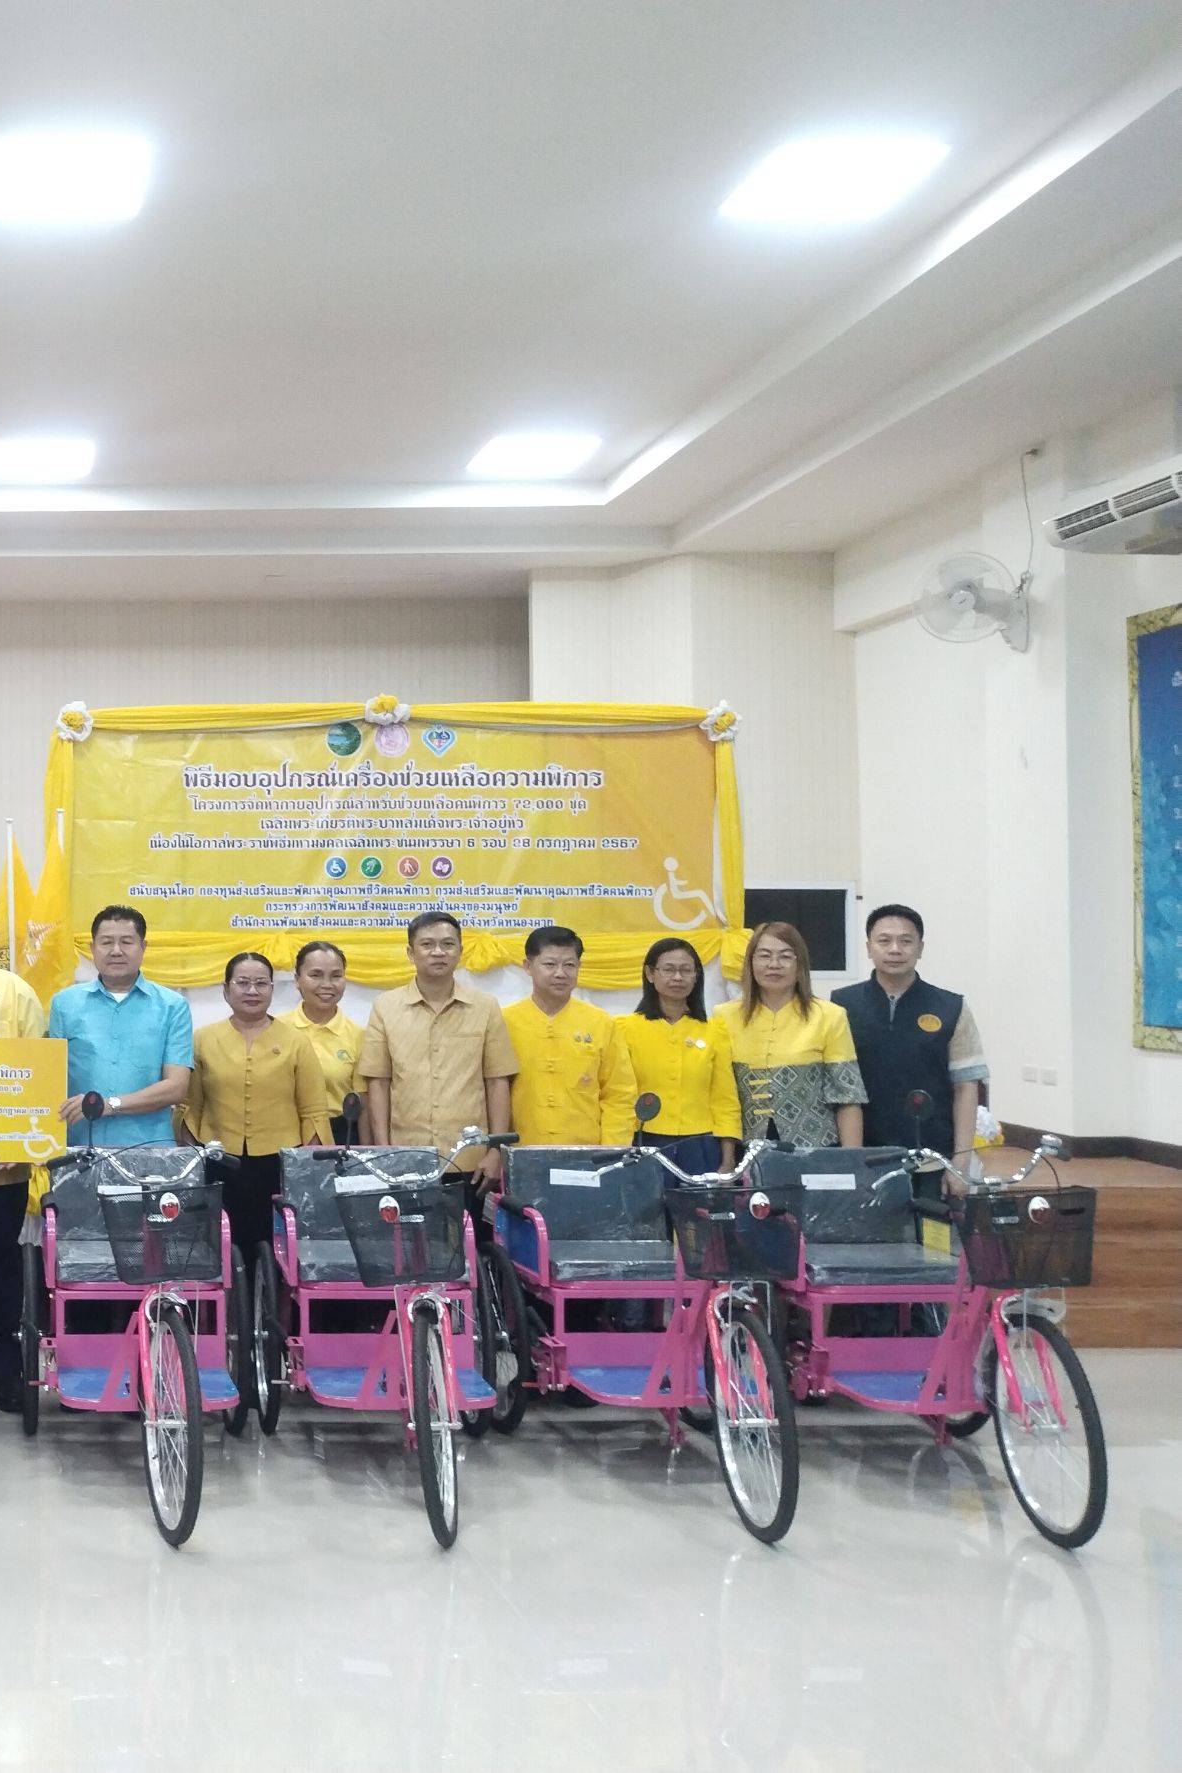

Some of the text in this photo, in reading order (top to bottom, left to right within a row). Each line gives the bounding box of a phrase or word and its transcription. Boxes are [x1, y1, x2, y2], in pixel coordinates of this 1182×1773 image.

[184, 762, 602, 796] พิธีมอบอุปกรณ์เครื่องช่วยเหลือความพิการ
[514, 799, 563, 812] 72,000
[570, 793, 587, 814] ชุด
[467, 838, 476, 848] 6
[481, 838, 507, 848] รอบ
[512, 838, 531, 848] 28
[536, 838, 596, 852] กรกฎาคม
[601, 838, 638, 848] 2567
[129, 882, 194, 898] สนับสนุนโดย
